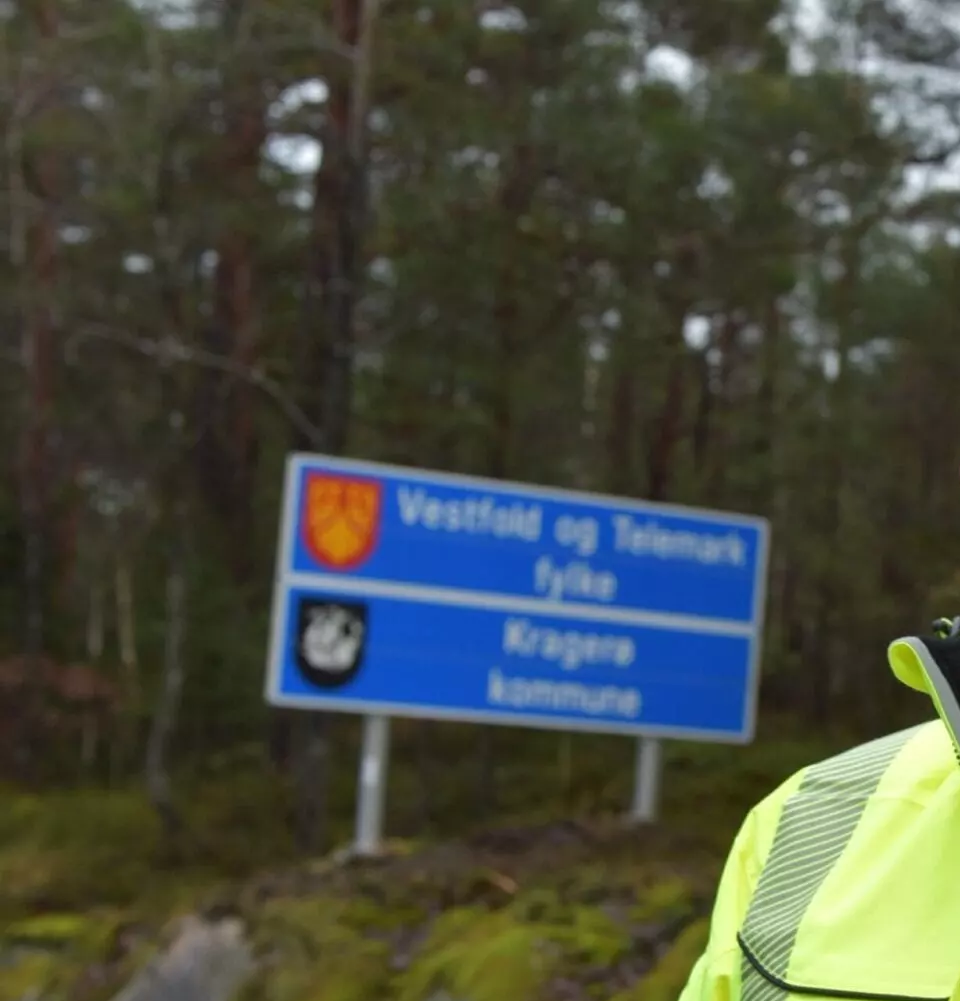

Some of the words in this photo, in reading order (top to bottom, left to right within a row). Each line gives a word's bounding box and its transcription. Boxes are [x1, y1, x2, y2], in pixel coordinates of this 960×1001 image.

[398, 485, 543, 542] Vestfold
[554, 513, 599, 556] og
[613, 513, 745, 566] Telemark
[534, 555, 616, 602] fylke
[503, 618, 635, 670] Kragerø
[488, 668, 641, 718] kommune
